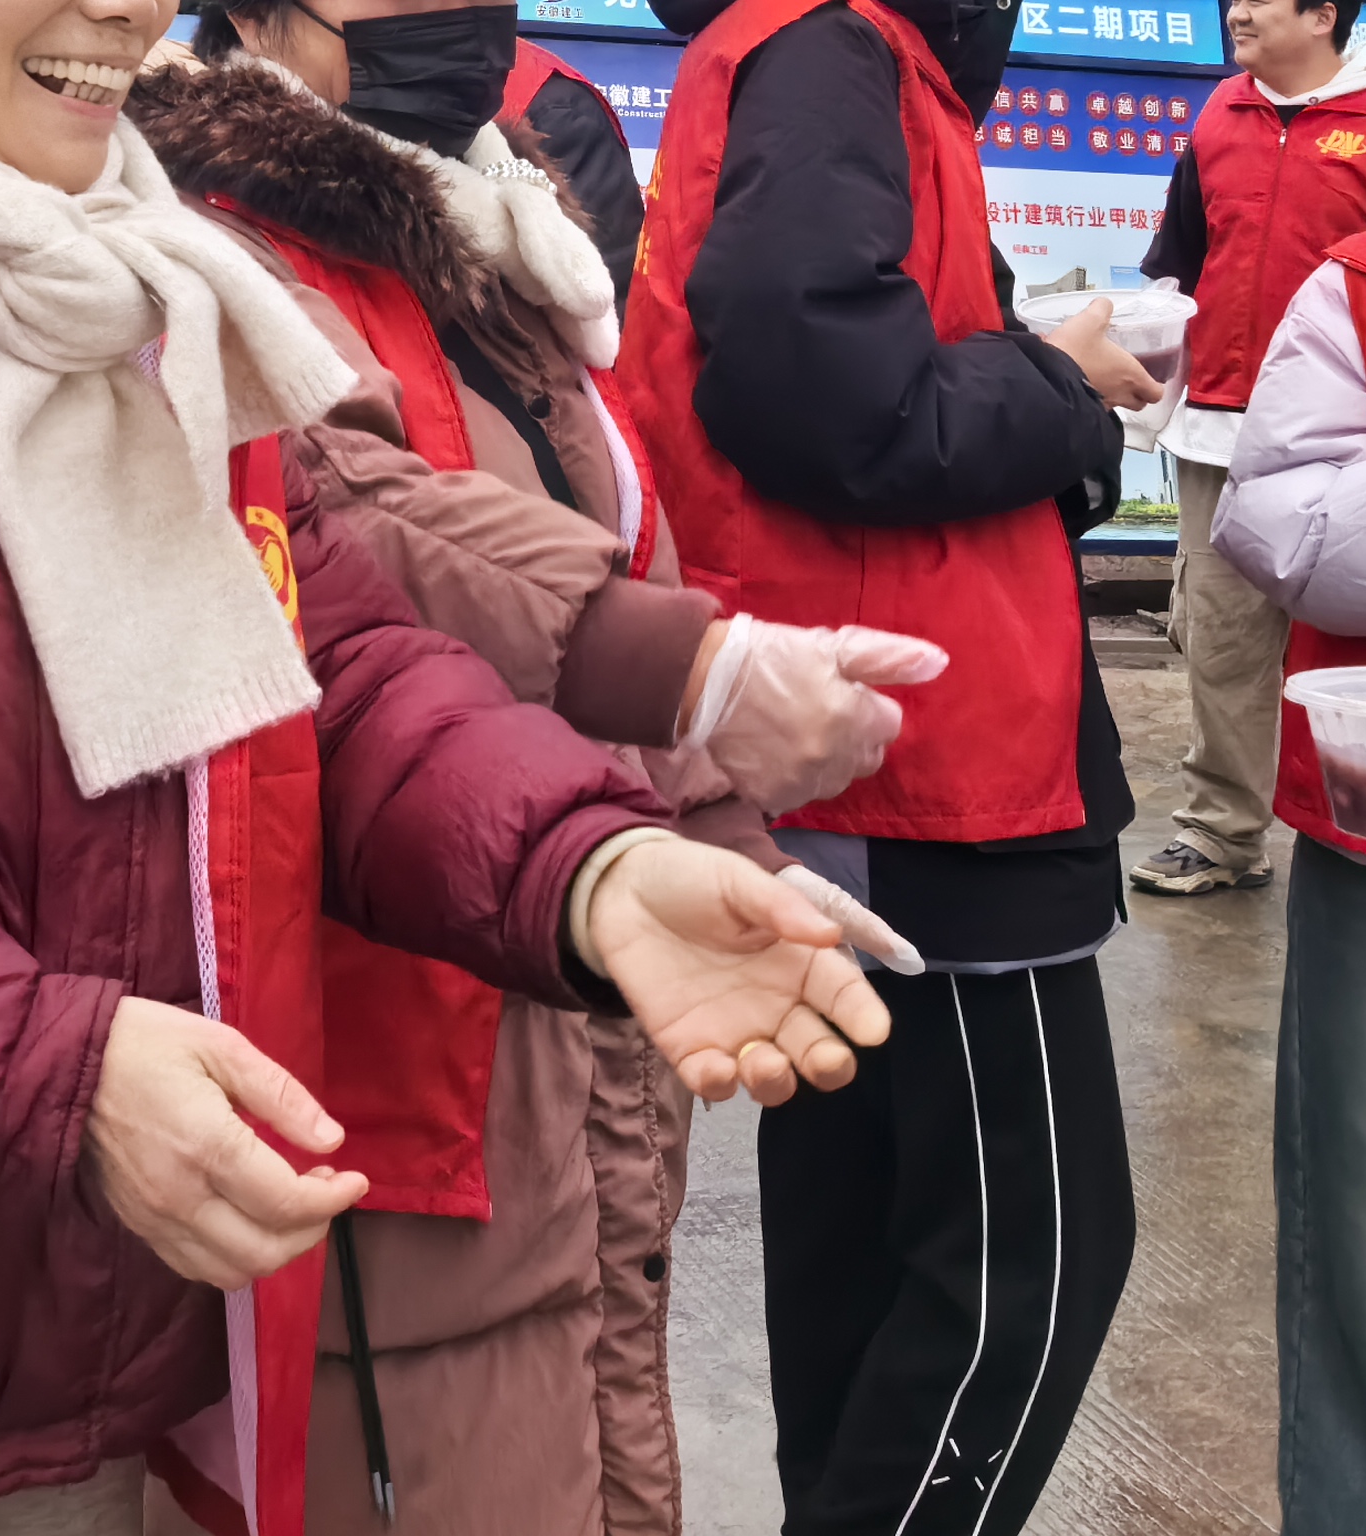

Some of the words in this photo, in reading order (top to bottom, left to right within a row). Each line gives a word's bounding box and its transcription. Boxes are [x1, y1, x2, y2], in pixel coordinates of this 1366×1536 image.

[1022, 1, 1194, 46] 区二期项目
[1091, 96, 1187, 119] 卓越创新
[1093, 131, 1189, 153] 敬业清正
